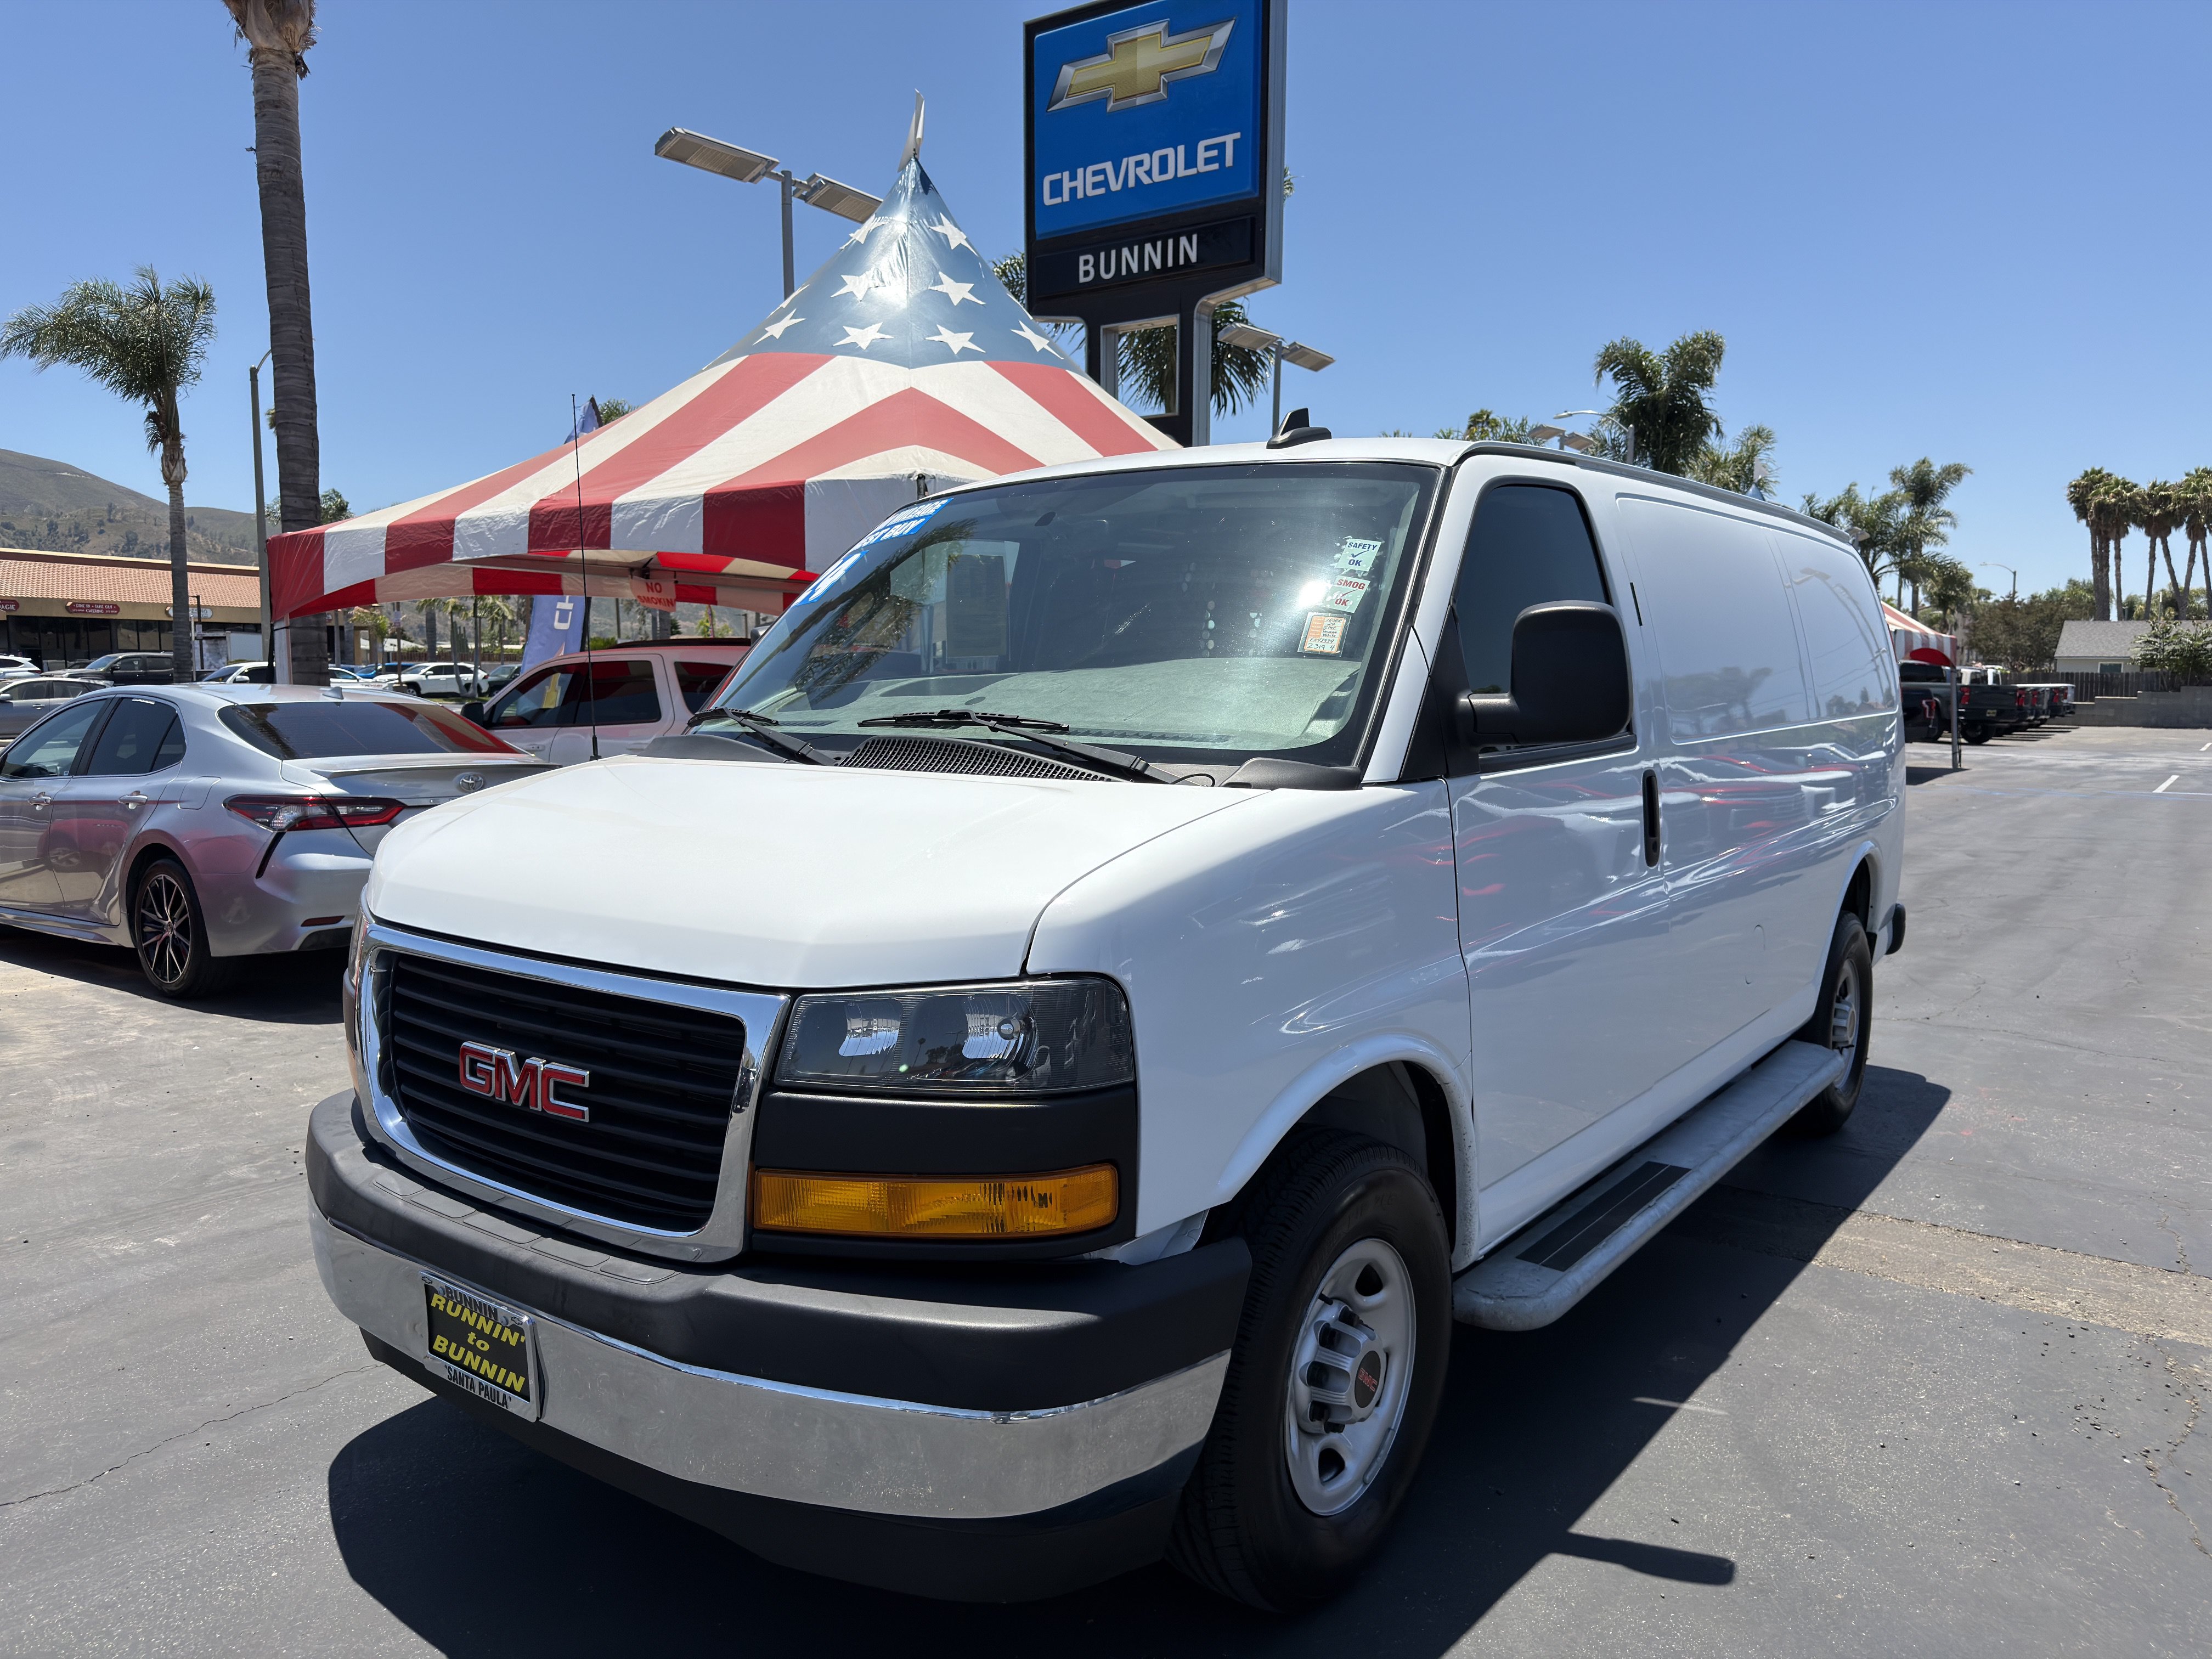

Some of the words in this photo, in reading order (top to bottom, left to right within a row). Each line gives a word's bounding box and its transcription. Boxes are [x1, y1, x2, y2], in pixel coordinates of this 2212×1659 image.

[1043, 132, 1241, 206] CHEVROLET
[1079, 233, 1198, 284] BUNNIN
[880, 518, 926, 540] BUY
[1347, 542, 1378, 550] SAFETY
[646, 582, 662, 593] NO
[1336, 579, 1365, 590] SMOG
[1335, 598, 1350, 606] OK
[459, 1041, 590, 1122] GMC
[444, 1285, 498, 1321] BUNNIN
[430, 1294, 526, 1347] RUNNIN'
[467, 1331, 490, 1351] to
[432, 1334, 526, 1392] BUNNIN
[1358, 1367, 1378, 1392] GMC
